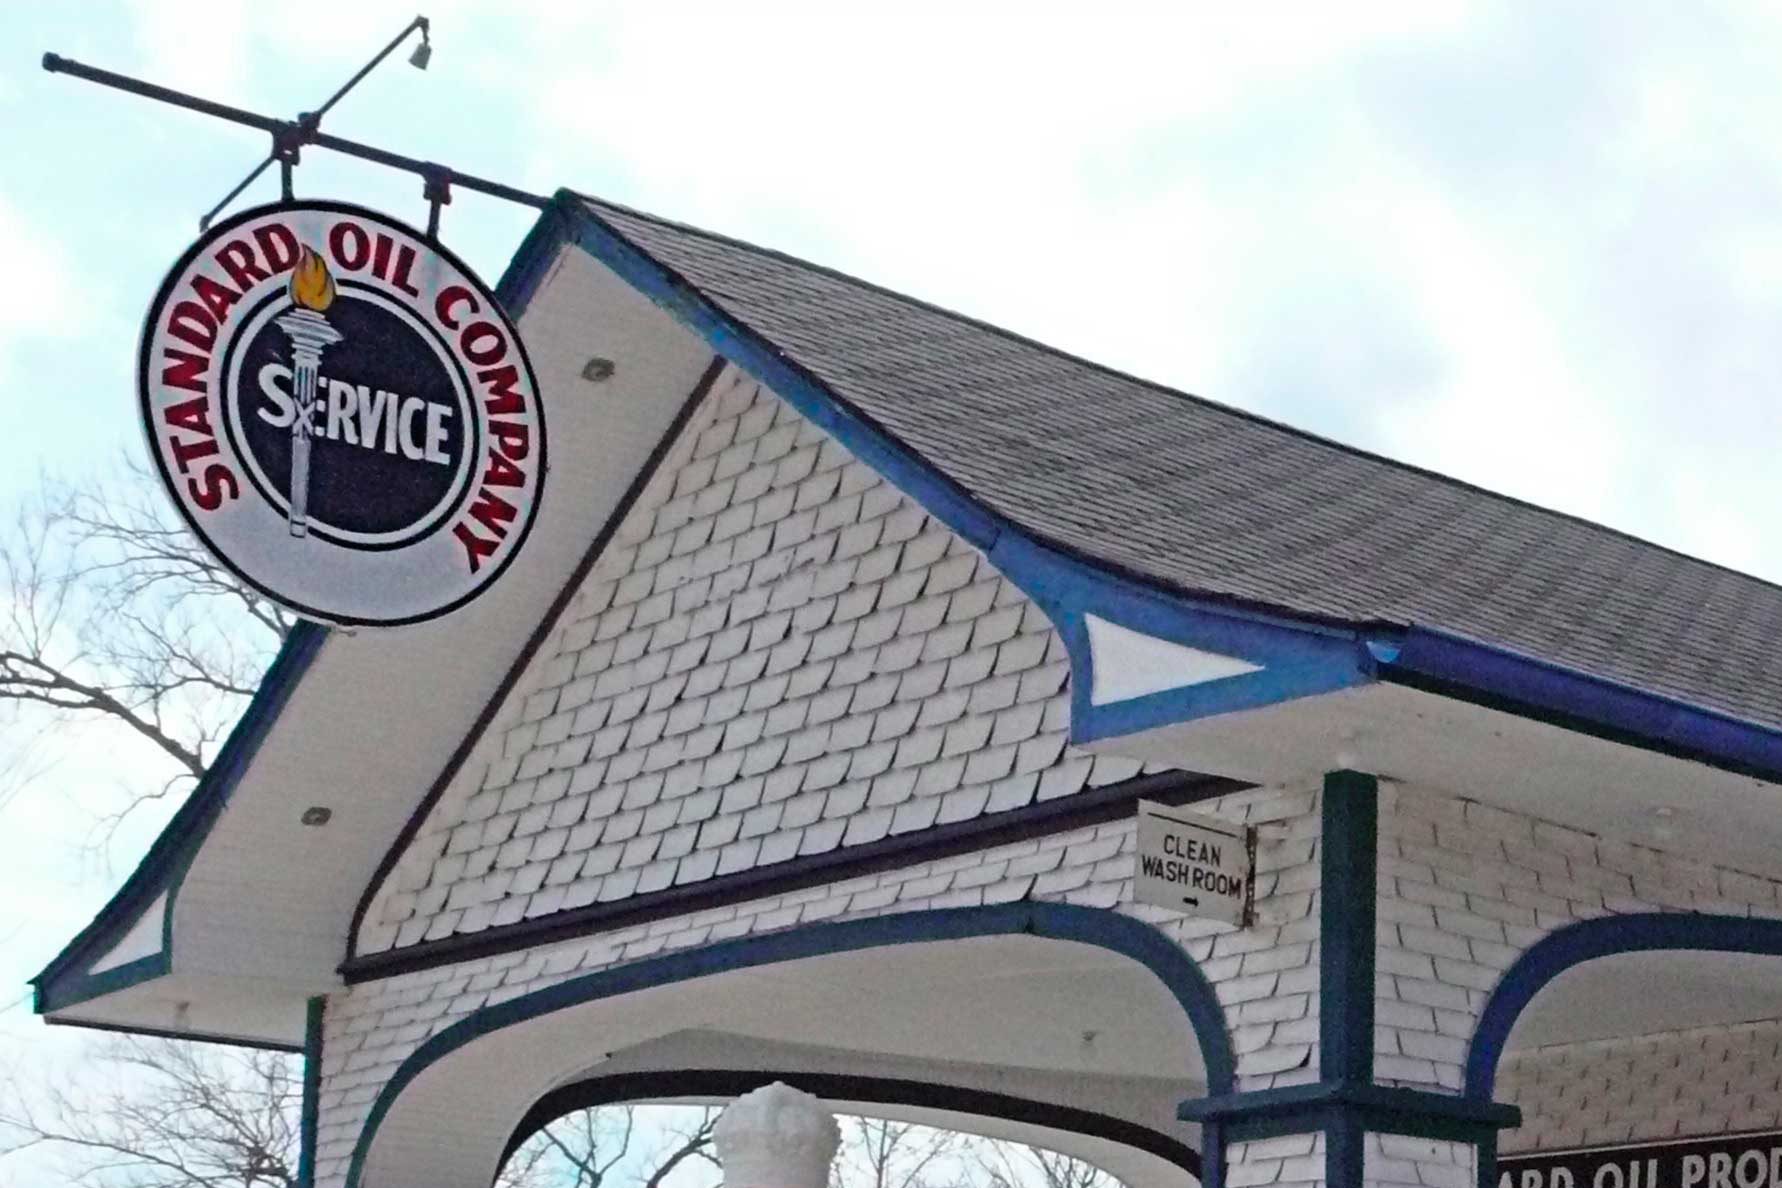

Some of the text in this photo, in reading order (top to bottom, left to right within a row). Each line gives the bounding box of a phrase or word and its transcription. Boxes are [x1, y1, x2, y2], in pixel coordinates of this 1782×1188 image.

[162, 221, 530, 575] STANDARD OIL COMPANY
[1163, 834, 1222, 867] CLEAN
